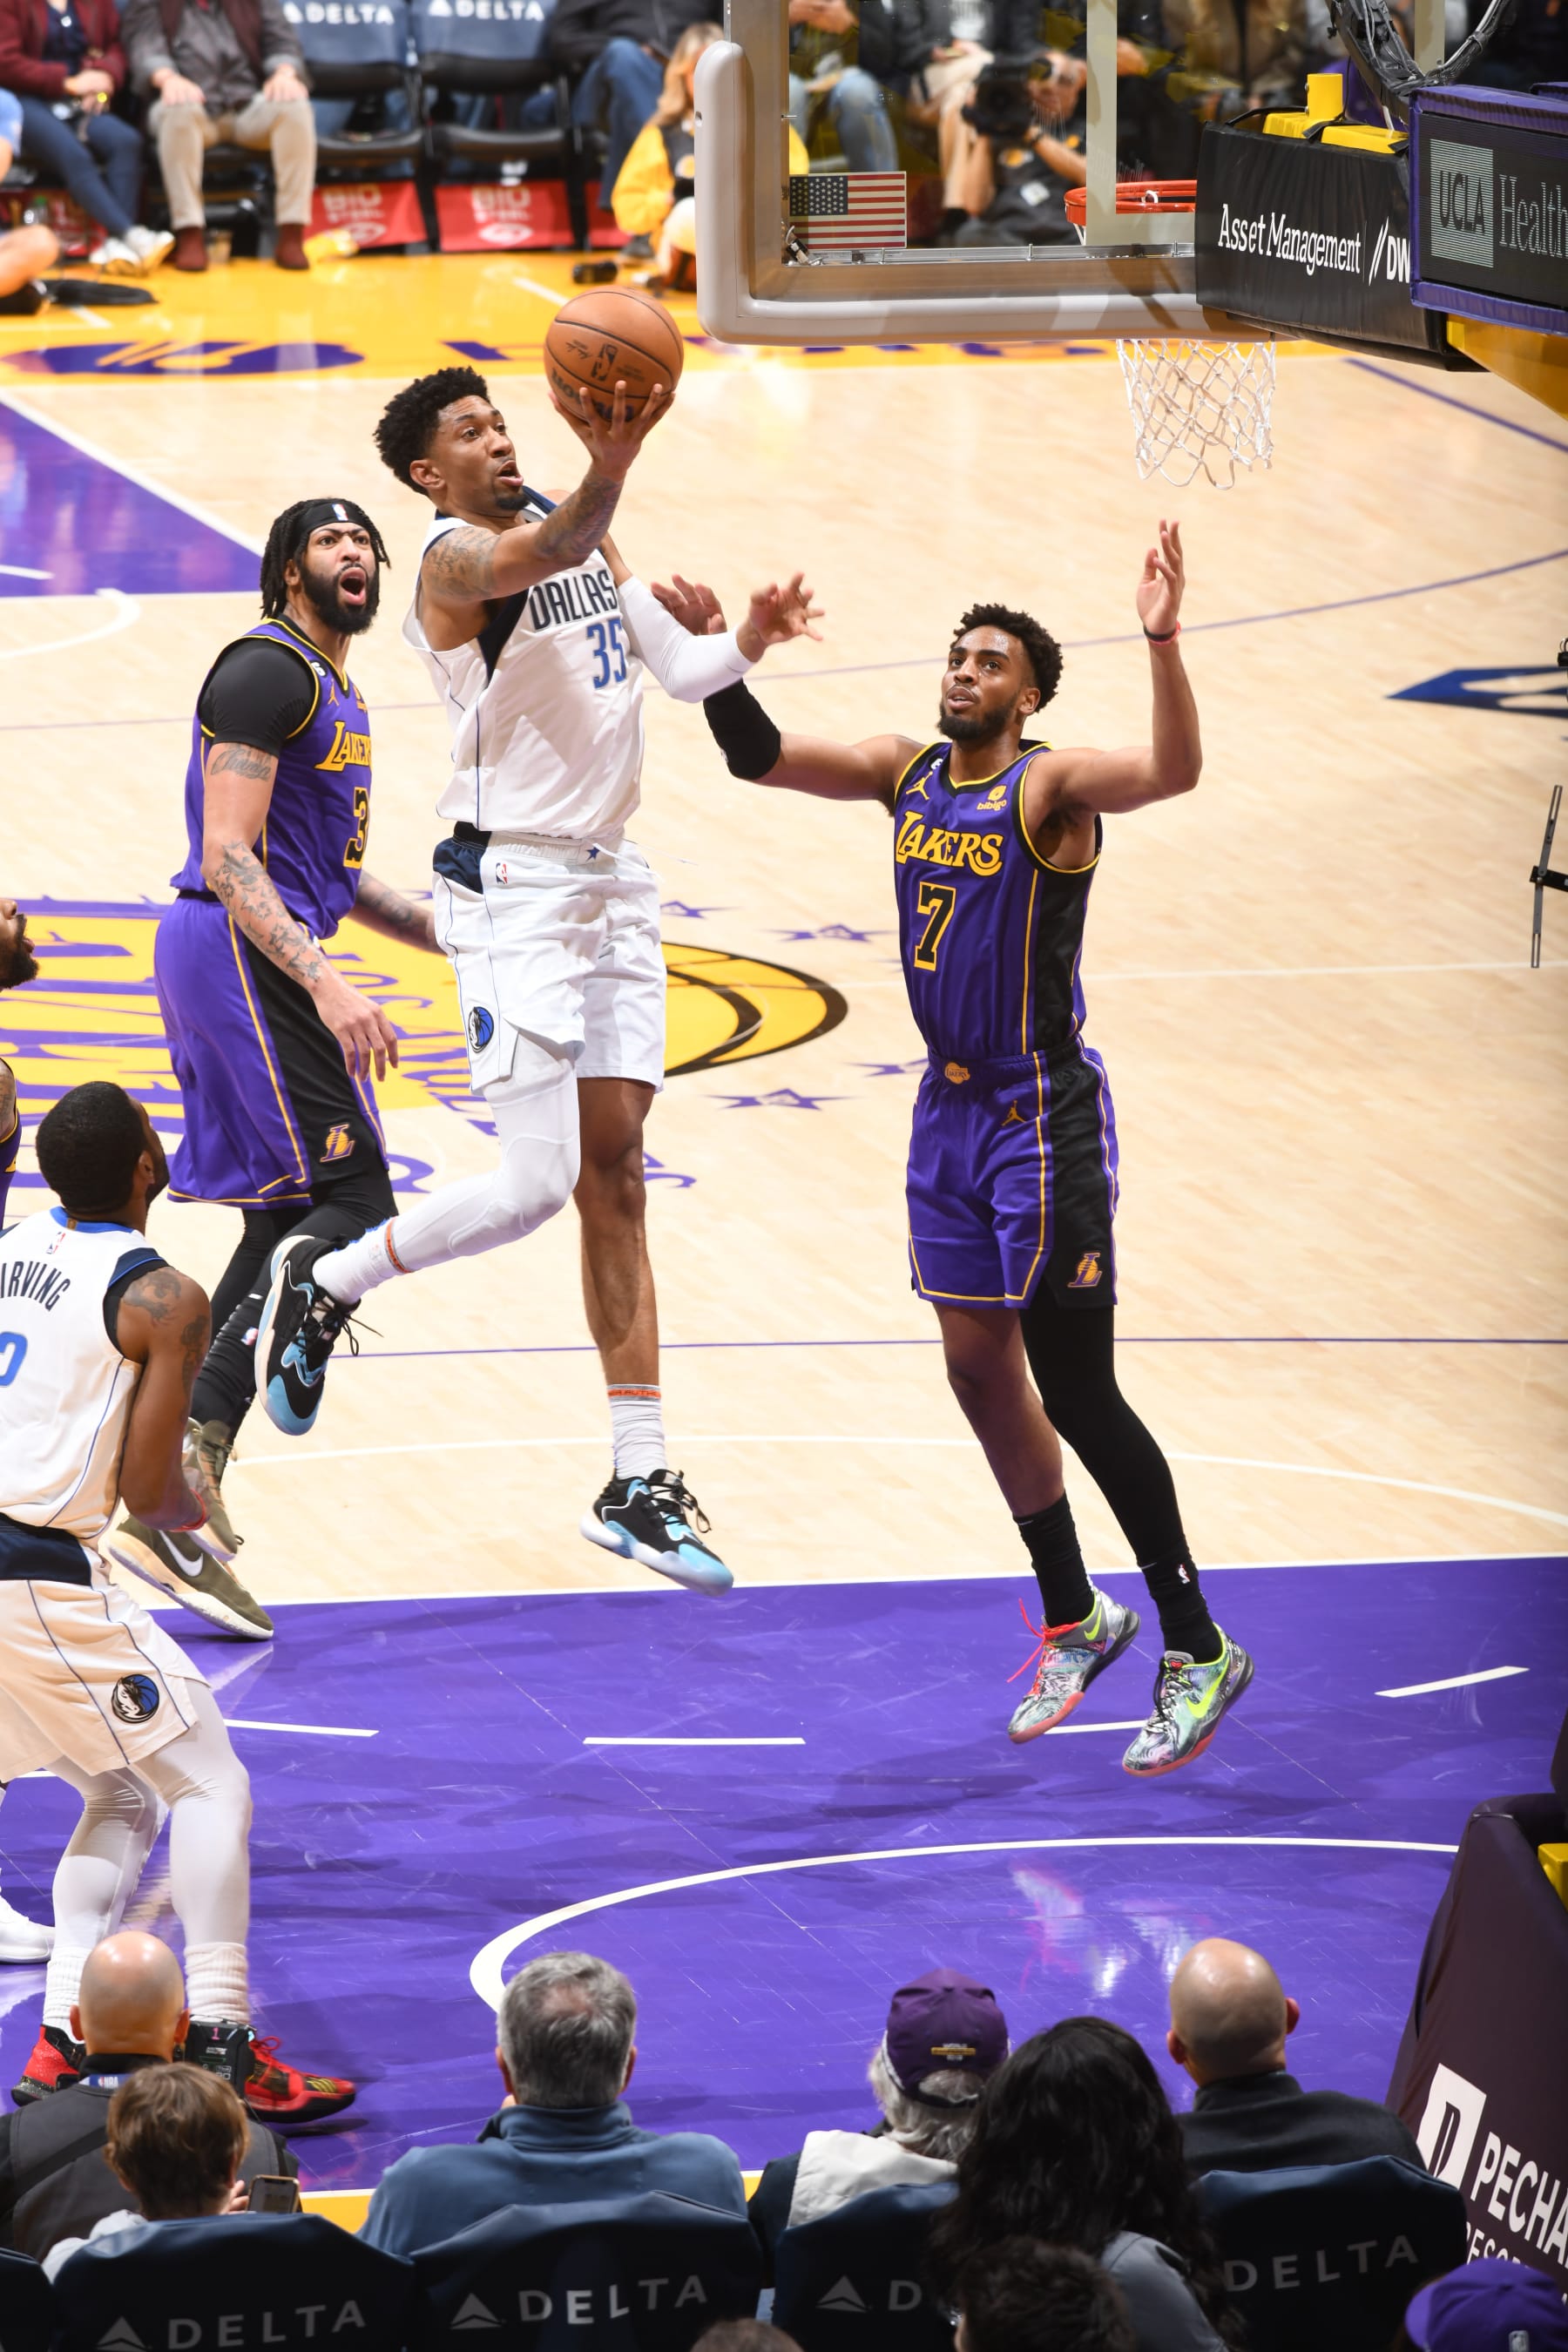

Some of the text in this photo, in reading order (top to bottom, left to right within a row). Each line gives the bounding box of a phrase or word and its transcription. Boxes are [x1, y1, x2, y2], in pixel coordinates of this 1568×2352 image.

[305, 1, 395, 24] DELTA
[454, 0, 545, 21] DELTA
[1218, 204, 1410, 283] Asset Management DW
[1438, 172, 1568, 259] UCLA Health
[528, 570, 618, 631] DALLAS
[586, 618, 627, 689] 35
[314, 720, 372, 772] LAKER
[342, 787, 369, 869] 3
[977, 799, 1007, 812] bibigo
[895, 811, 1004, 876] LAKERS
[914, 881, 956, 972] 7
[0, 1260, 71, 1311] IRVING
[1470, 2131, 1568, 2270] PECHA
[1224, 2234, 1419, 2293] DELTA
[167, 2300, 366, 2349] DELTA
[517, 2274, 708, 2325] DELTA
